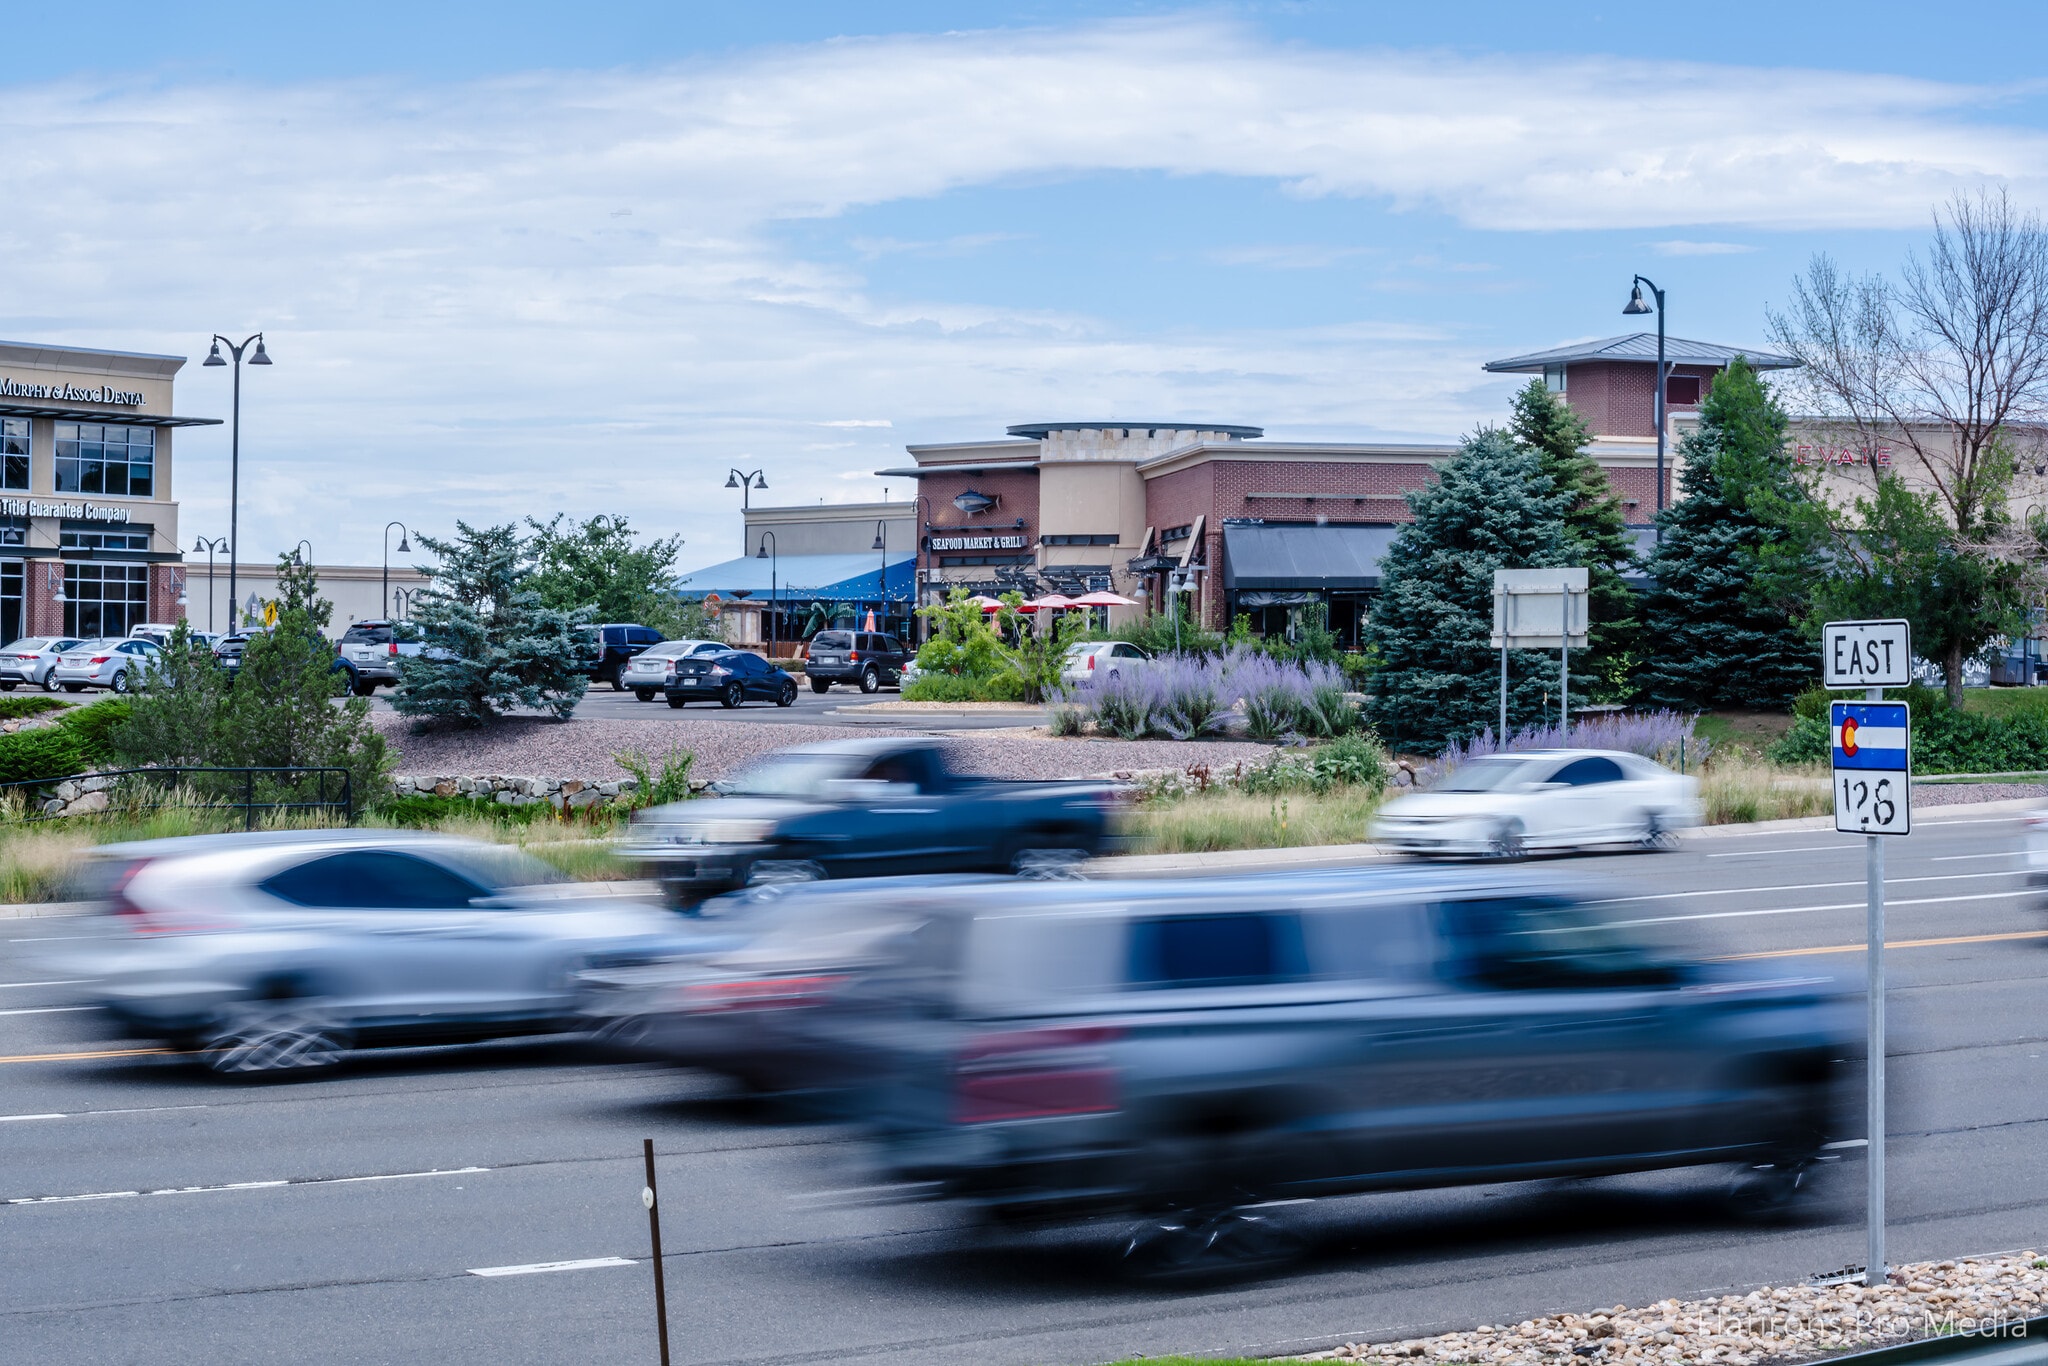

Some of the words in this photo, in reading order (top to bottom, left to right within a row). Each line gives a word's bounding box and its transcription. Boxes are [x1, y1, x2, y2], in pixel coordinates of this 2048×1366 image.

[0, 378, 50, 398] MURPHY
[53, 386, 61, 399] &
[103, 386, 146, 406] DENTAL
[2, 498, 27, 516] Title
[29, 500, 83, 518] Guarantee
[85, 502, 131, 524] Company
[932, 537, 963, 550] SEAFOOD
[963, 536, 992, 549] MARKET
[993, 538, 1000, 549] &
[1000, 536, 1022, 548] GRILL
[1834, 635, 1894, 676] EAST
